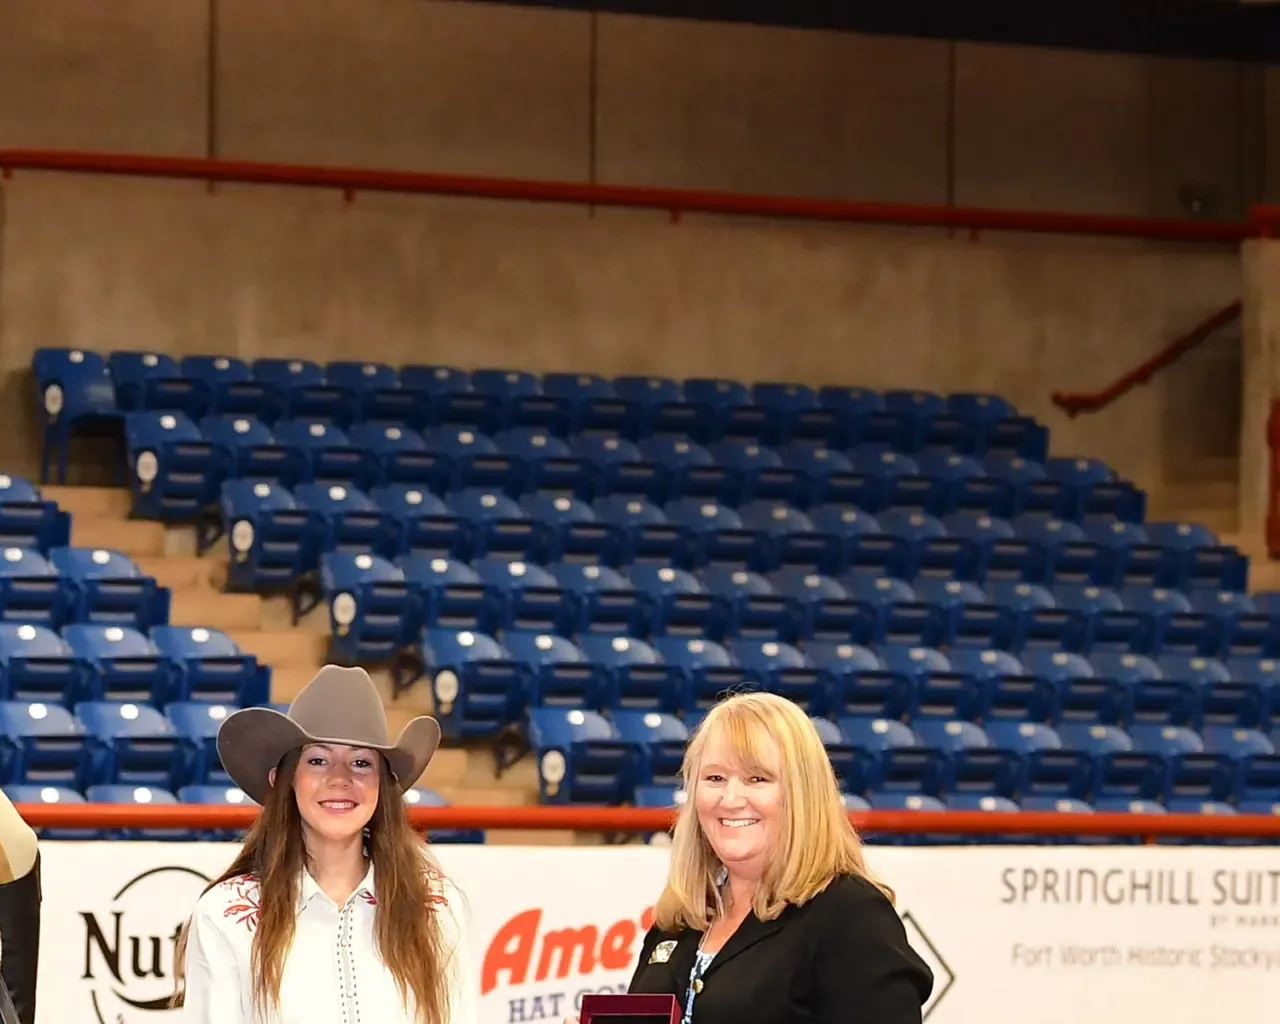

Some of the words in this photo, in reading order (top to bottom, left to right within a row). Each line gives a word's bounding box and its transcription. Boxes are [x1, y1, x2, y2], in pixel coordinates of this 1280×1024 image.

[1000, 867, 1199, 905] SPRINGHILL
[1011, 943, 1052, 966] Fort
[1060, 943, 1122, 966] Worth
[509, 993, 565, 1023] HAT
